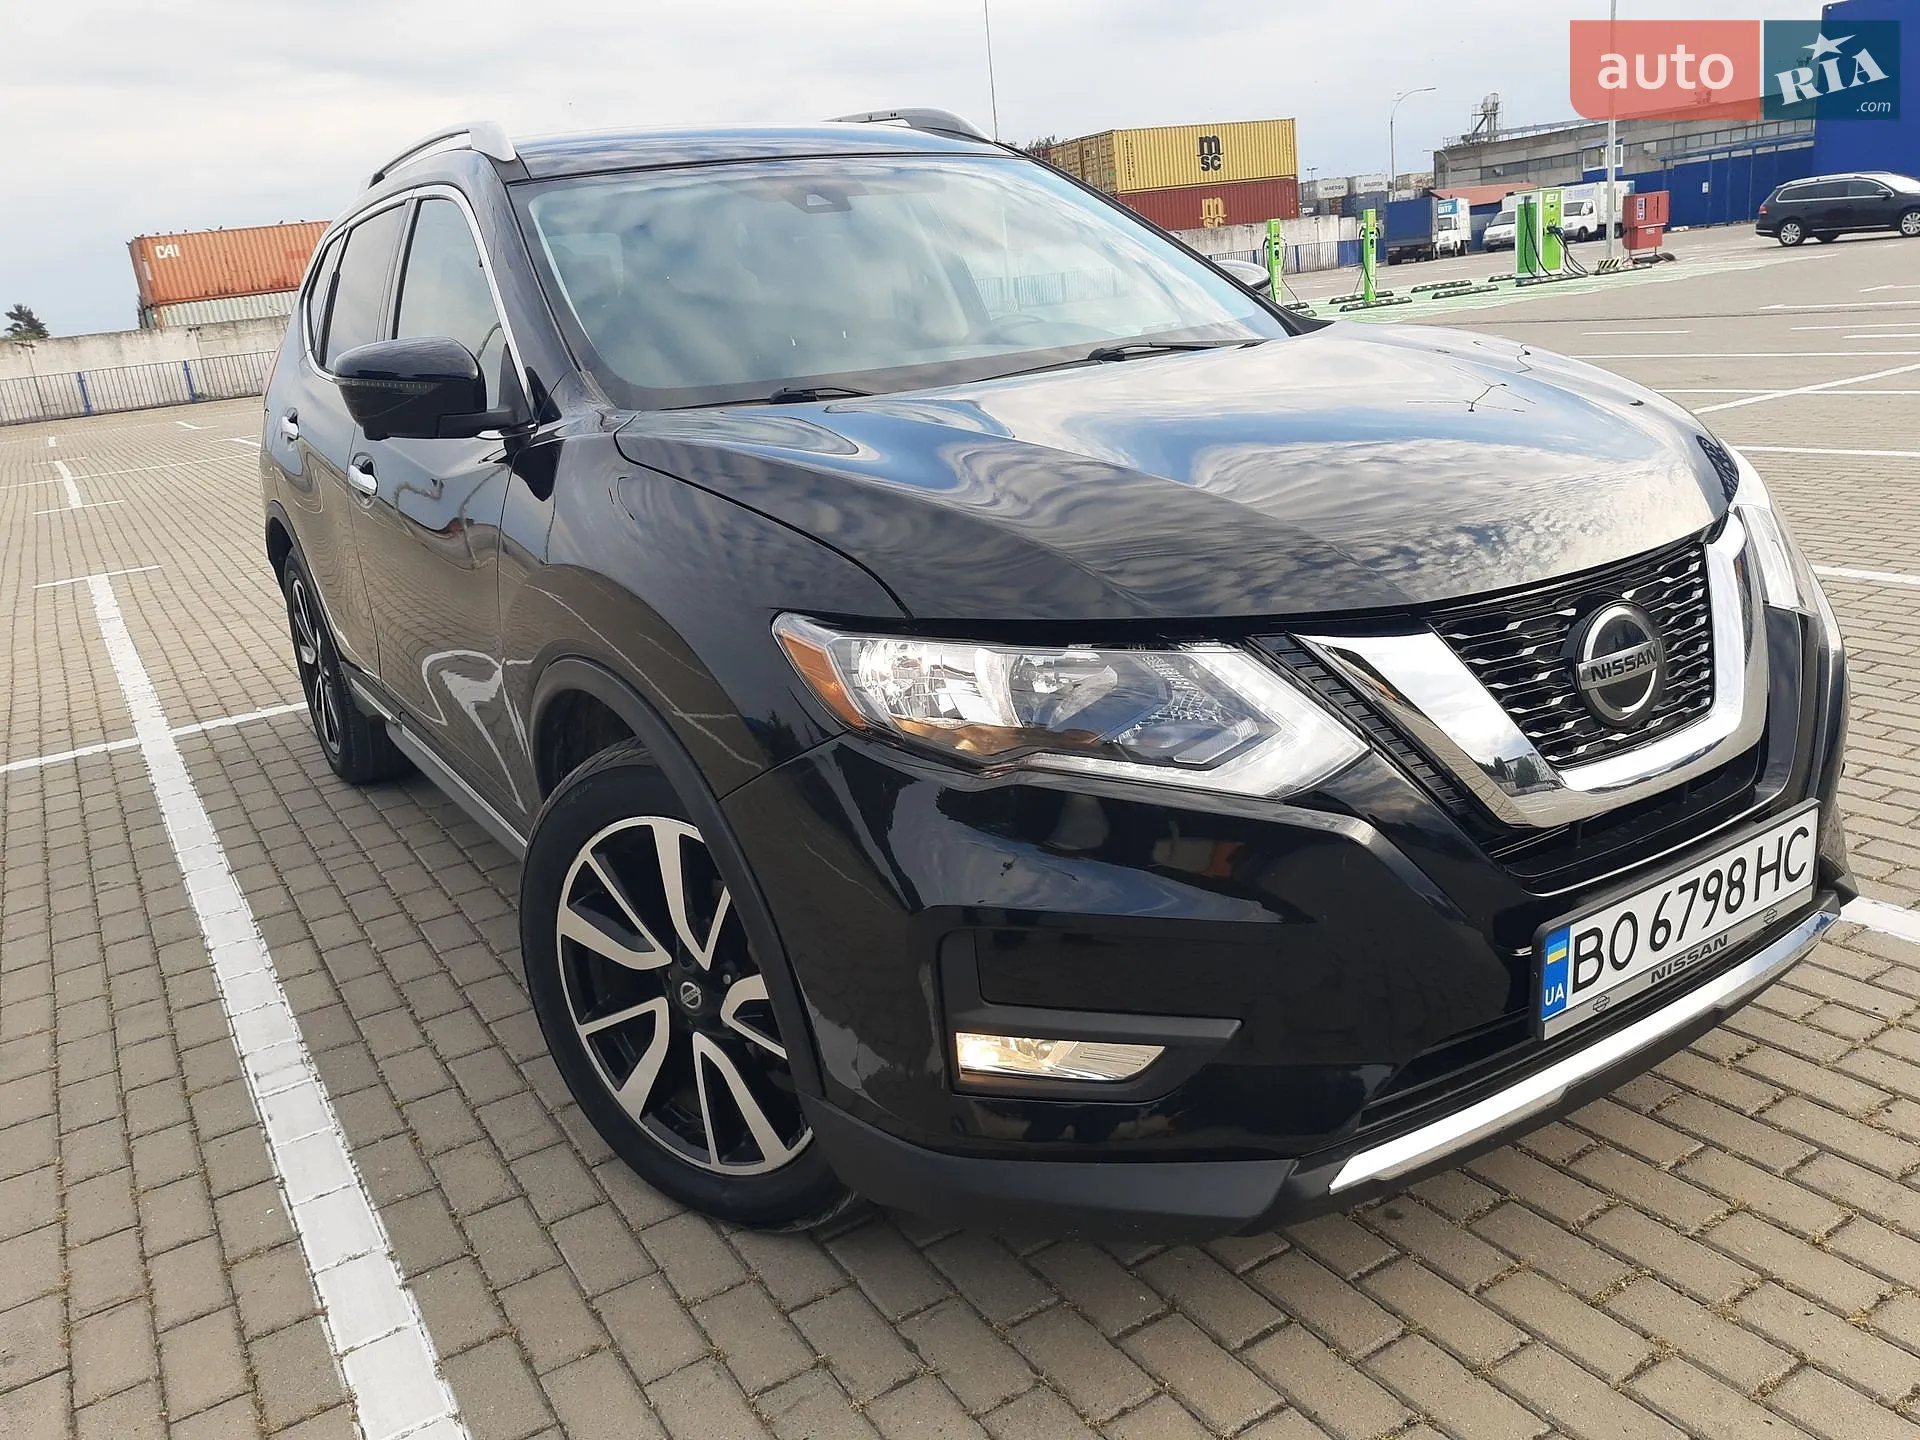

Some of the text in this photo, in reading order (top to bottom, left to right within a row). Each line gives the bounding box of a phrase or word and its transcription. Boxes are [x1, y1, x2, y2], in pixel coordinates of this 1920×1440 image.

[155, 244, 180, 259] CAI
[1590, 646, 1657, 682] NISSAN
[1571, 826, 1809, 994] BO 6798 HC
[1650, 934, 1728, 984] NISSAN
[1545, 986, 1565, 1006] UA
